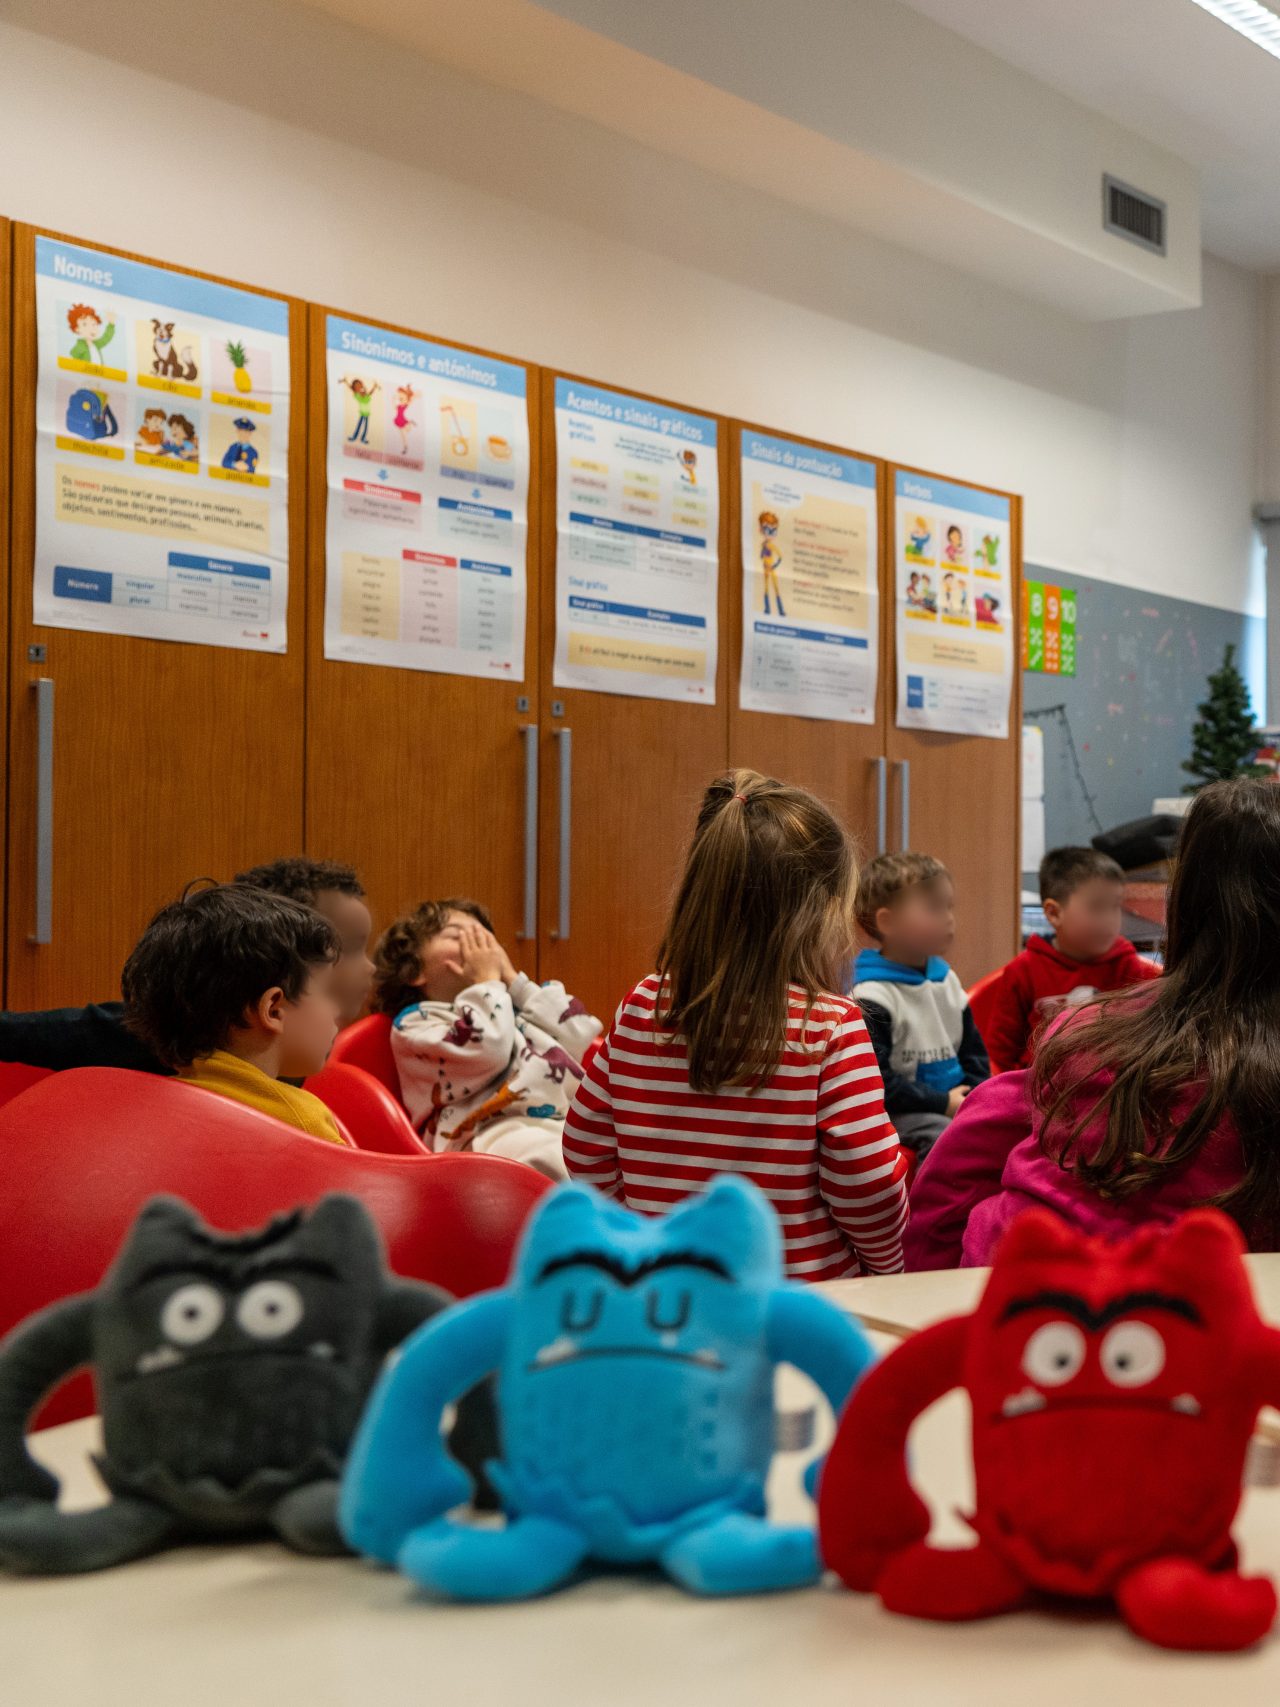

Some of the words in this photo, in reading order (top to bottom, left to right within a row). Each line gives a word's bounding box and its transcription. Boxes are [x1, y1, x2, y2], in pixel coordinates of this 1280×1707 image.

[54, 255, 113, 287] Nomes
[341, 330, 415, 364] Sinónimos
[417, 354, 426, 369] e
[428, 355, 497, 387] antónimos
[566, 390, 613, 417] Acentos
[614, 406, 622, 418] e
[624, 406, 658, 429] sinais
[660, 417, 704, 441] gráficos
[751, 441, 782, 463] Sinais
[782, 451, 794, 465] de
[795, 455, 842, 478] pontuação
[62, 488, 77, 499] São
[79, 492, 113, 505] palavras
[116, 499, 129, 508] que
[131, 500, 168, 515] designam
[74, 478, 100, 491] nomes
[102, 483, 128, 496] podem
[130, 488, 153, 500] variar
[1031, 593, 1043, 617] 8
[1047, 596, 1058, 620] 9
[1061, 600, 1077, 624] 10
